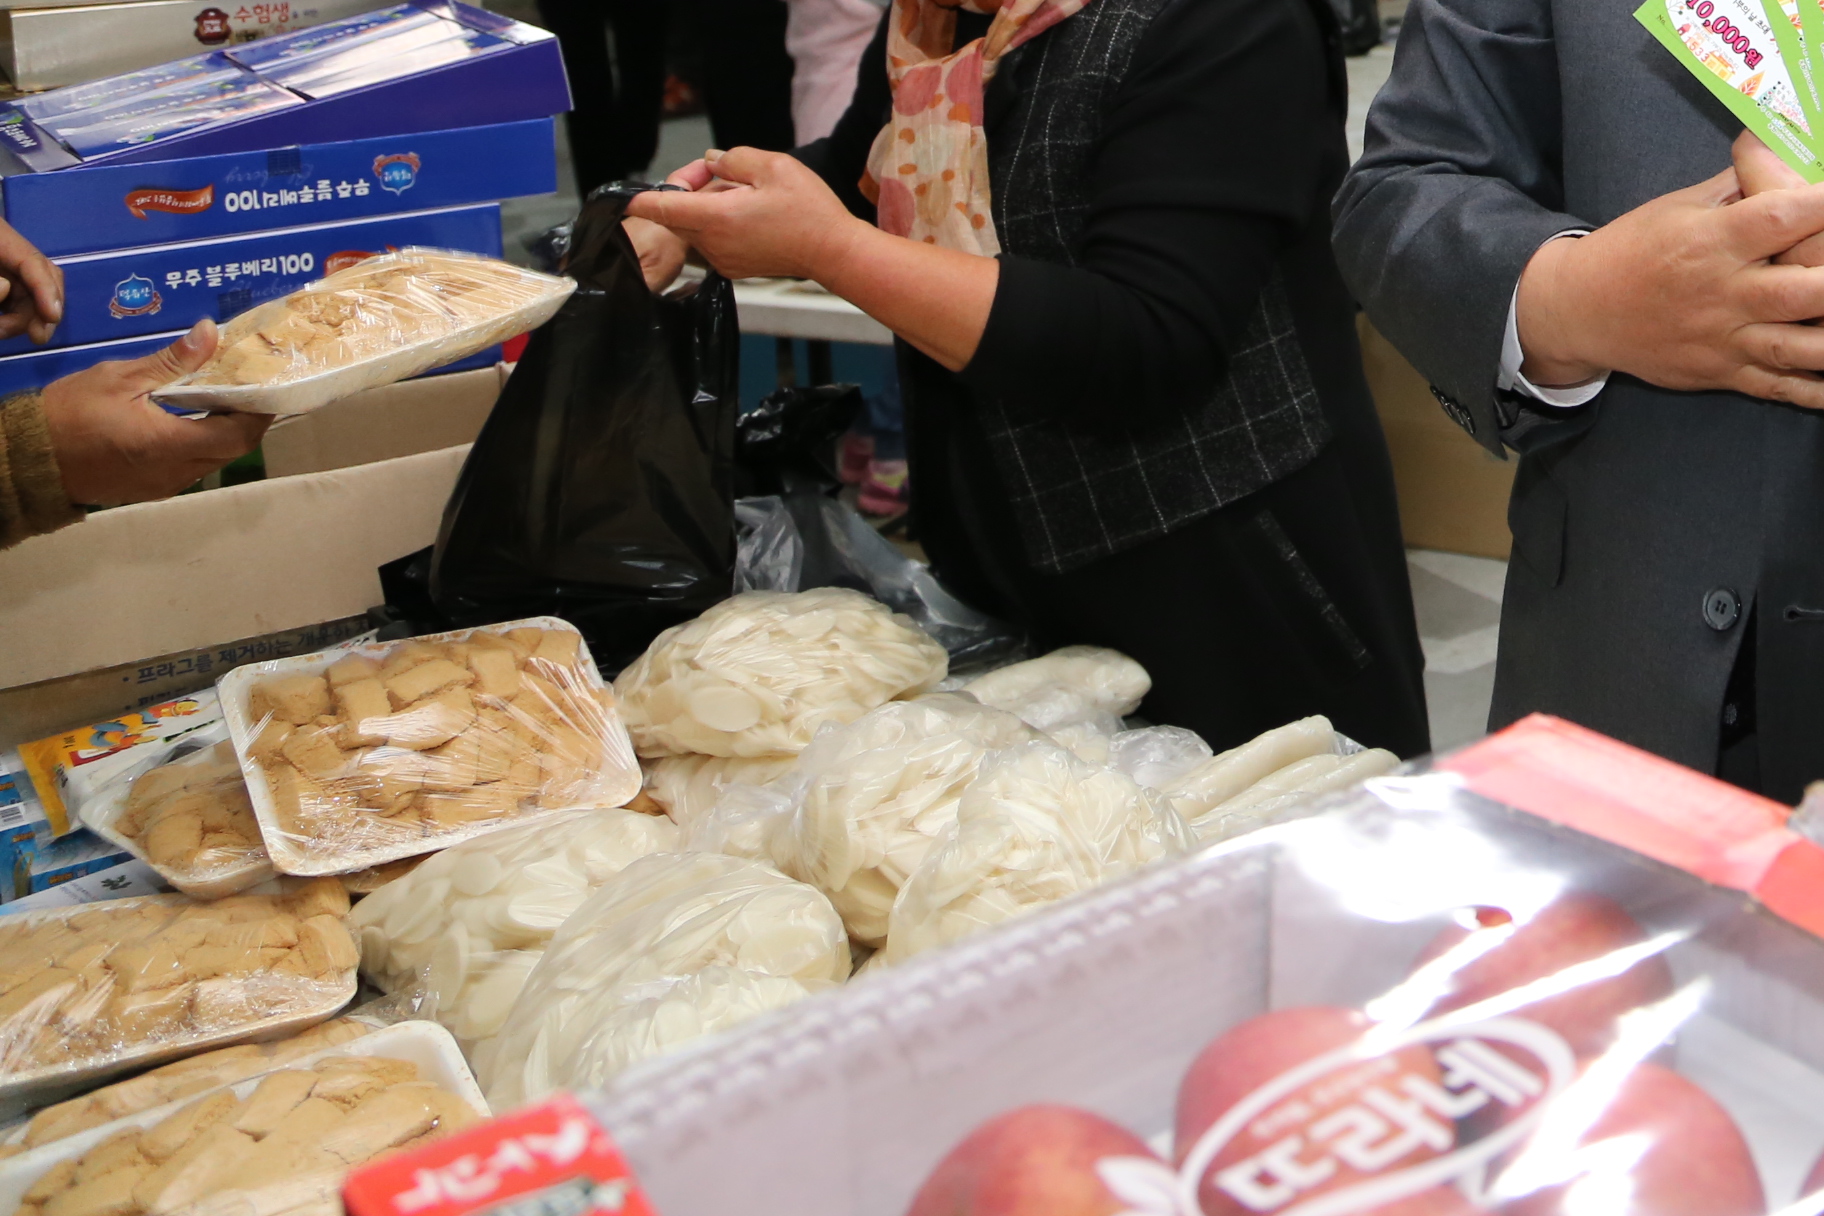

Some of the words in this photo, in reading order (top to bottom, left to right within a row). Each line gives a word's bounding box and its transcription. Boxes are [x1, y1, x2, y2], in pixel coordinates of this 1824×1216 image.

[1747, 11, 1758, 22] 날
[1754, 18, 1771, 35] 초대
[1682, 34, 1710, 63] 1533
[335, 178, 370, 198] 무주
[165, 270, 202, 289] 무주
[206, 253, 314, 287] 블루베리100
[137, 655, 213, 684] 프라그를
[219, 639, 293, 664] 제거하는
